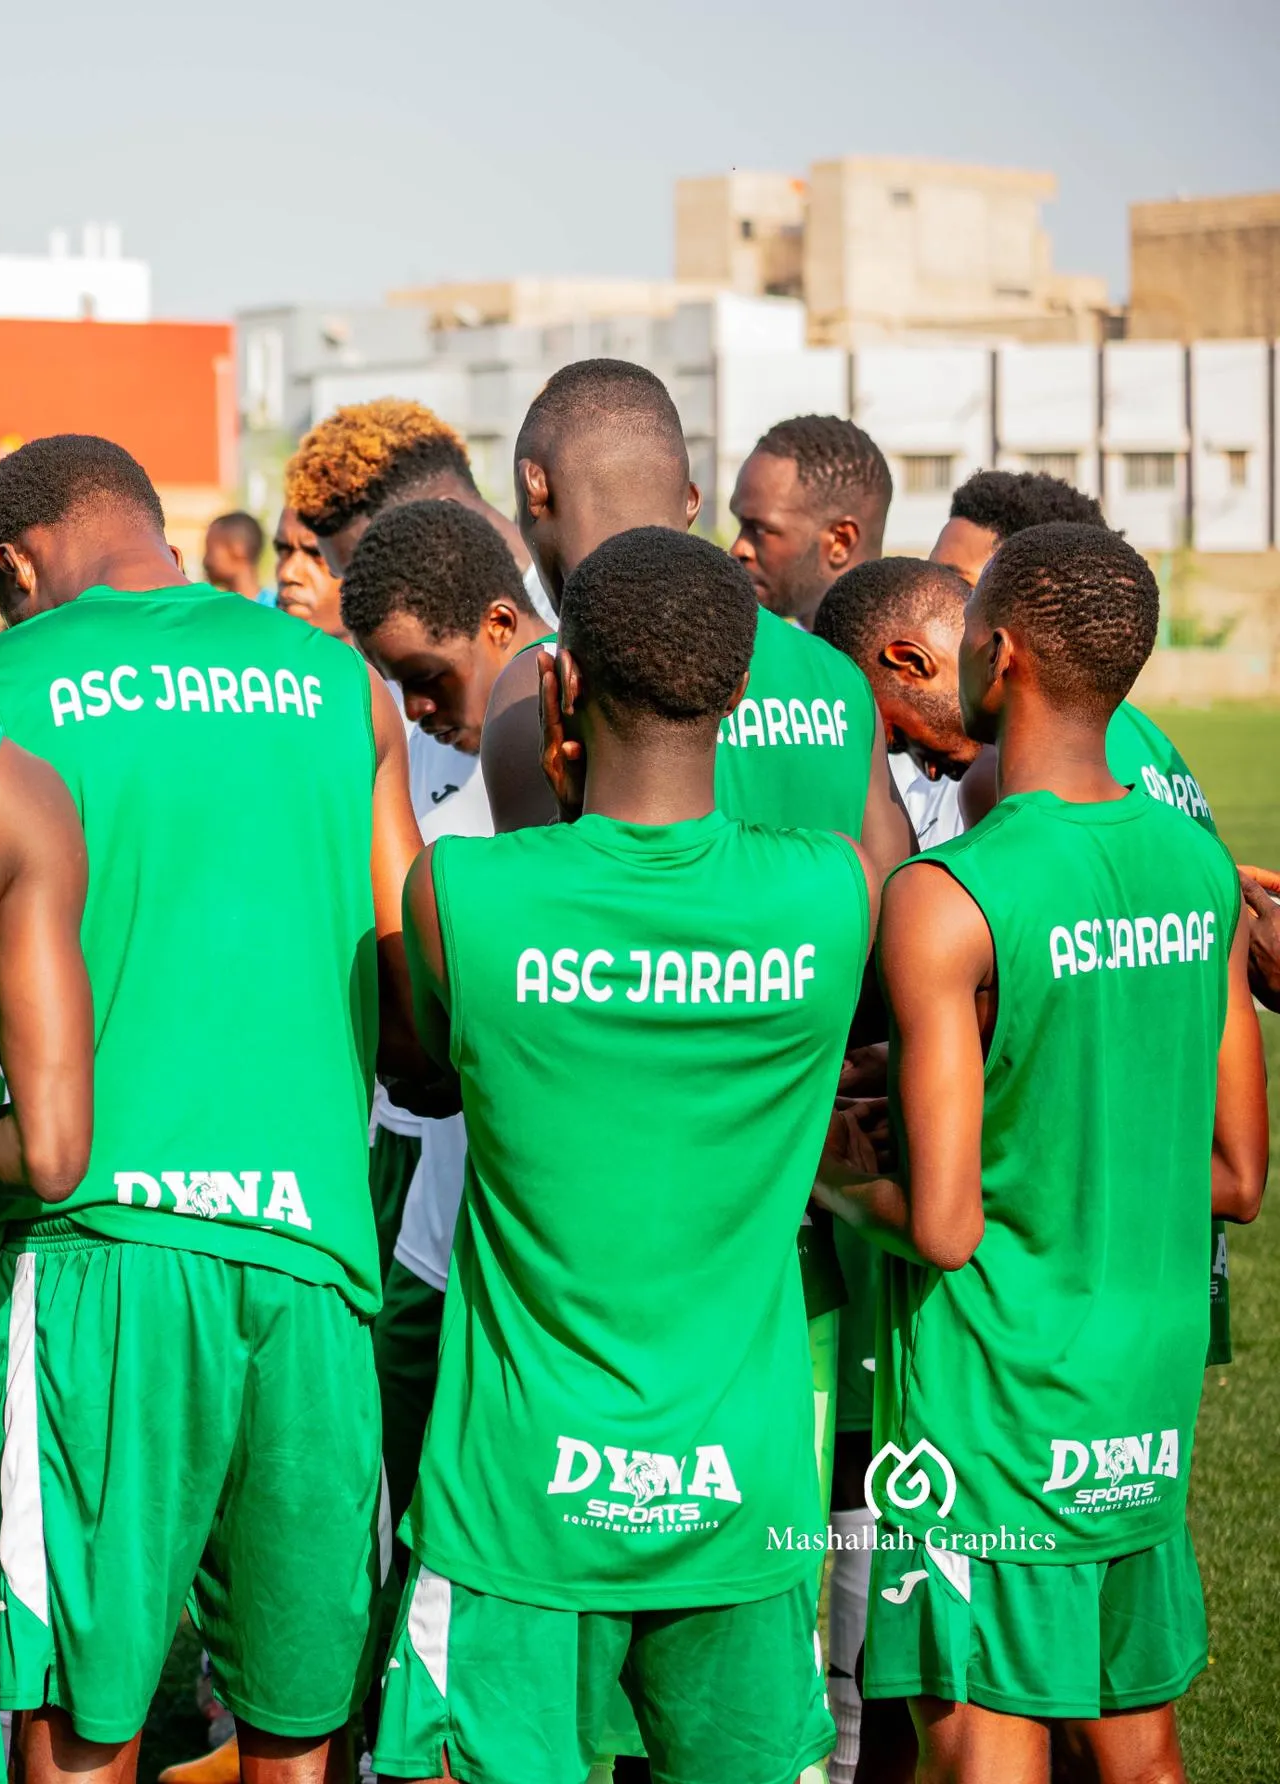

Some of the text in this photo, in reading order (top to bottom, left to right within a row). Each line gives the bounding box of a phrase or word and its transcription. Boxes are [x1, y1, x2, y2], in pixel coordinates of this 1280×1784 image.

[50, 665, 323, 727] ASC JARAAF
[1106, 911, 1215, 969] JARAAF
[517, 943, 815, 1004] ASC JARAAF
[113, 1171, 312, 1230] DYNA
[547, 1434, 743, 1505] DYNA
[1042, 1428, 1179, 1494] DYNA
[586, 1498, 702, 1525] SPORTS
[1073, 1480, 1156, 1506] SPORTS
[563, 1513, 719, 1534] EQUIPEMENTS SPORTIFS
